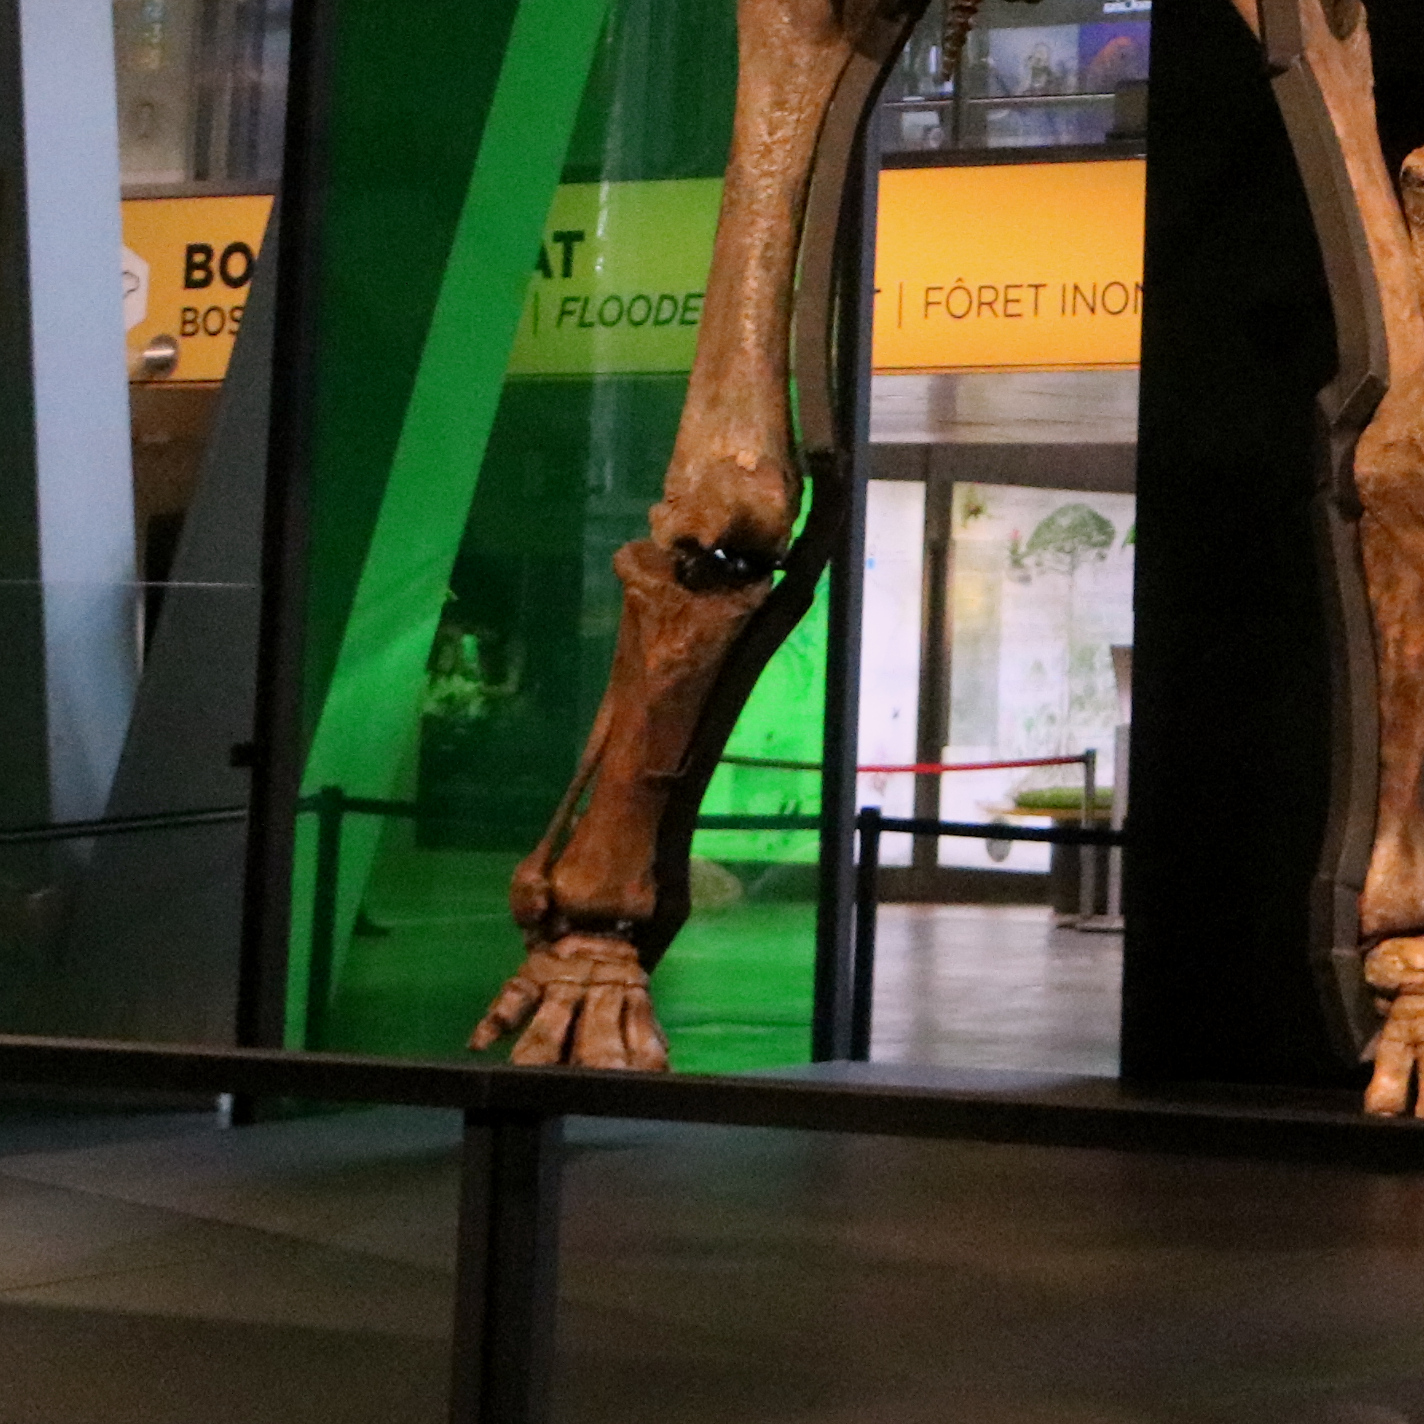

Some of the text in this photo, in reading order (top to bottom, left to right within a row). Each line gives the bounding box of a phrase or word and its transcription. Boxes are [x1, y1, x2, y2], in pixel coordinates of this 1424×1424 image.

[182, 241, 255, 290] BO
[555, 291, 706, 328] FLOODE
[923, 277, 1047, 319] FÔRET
